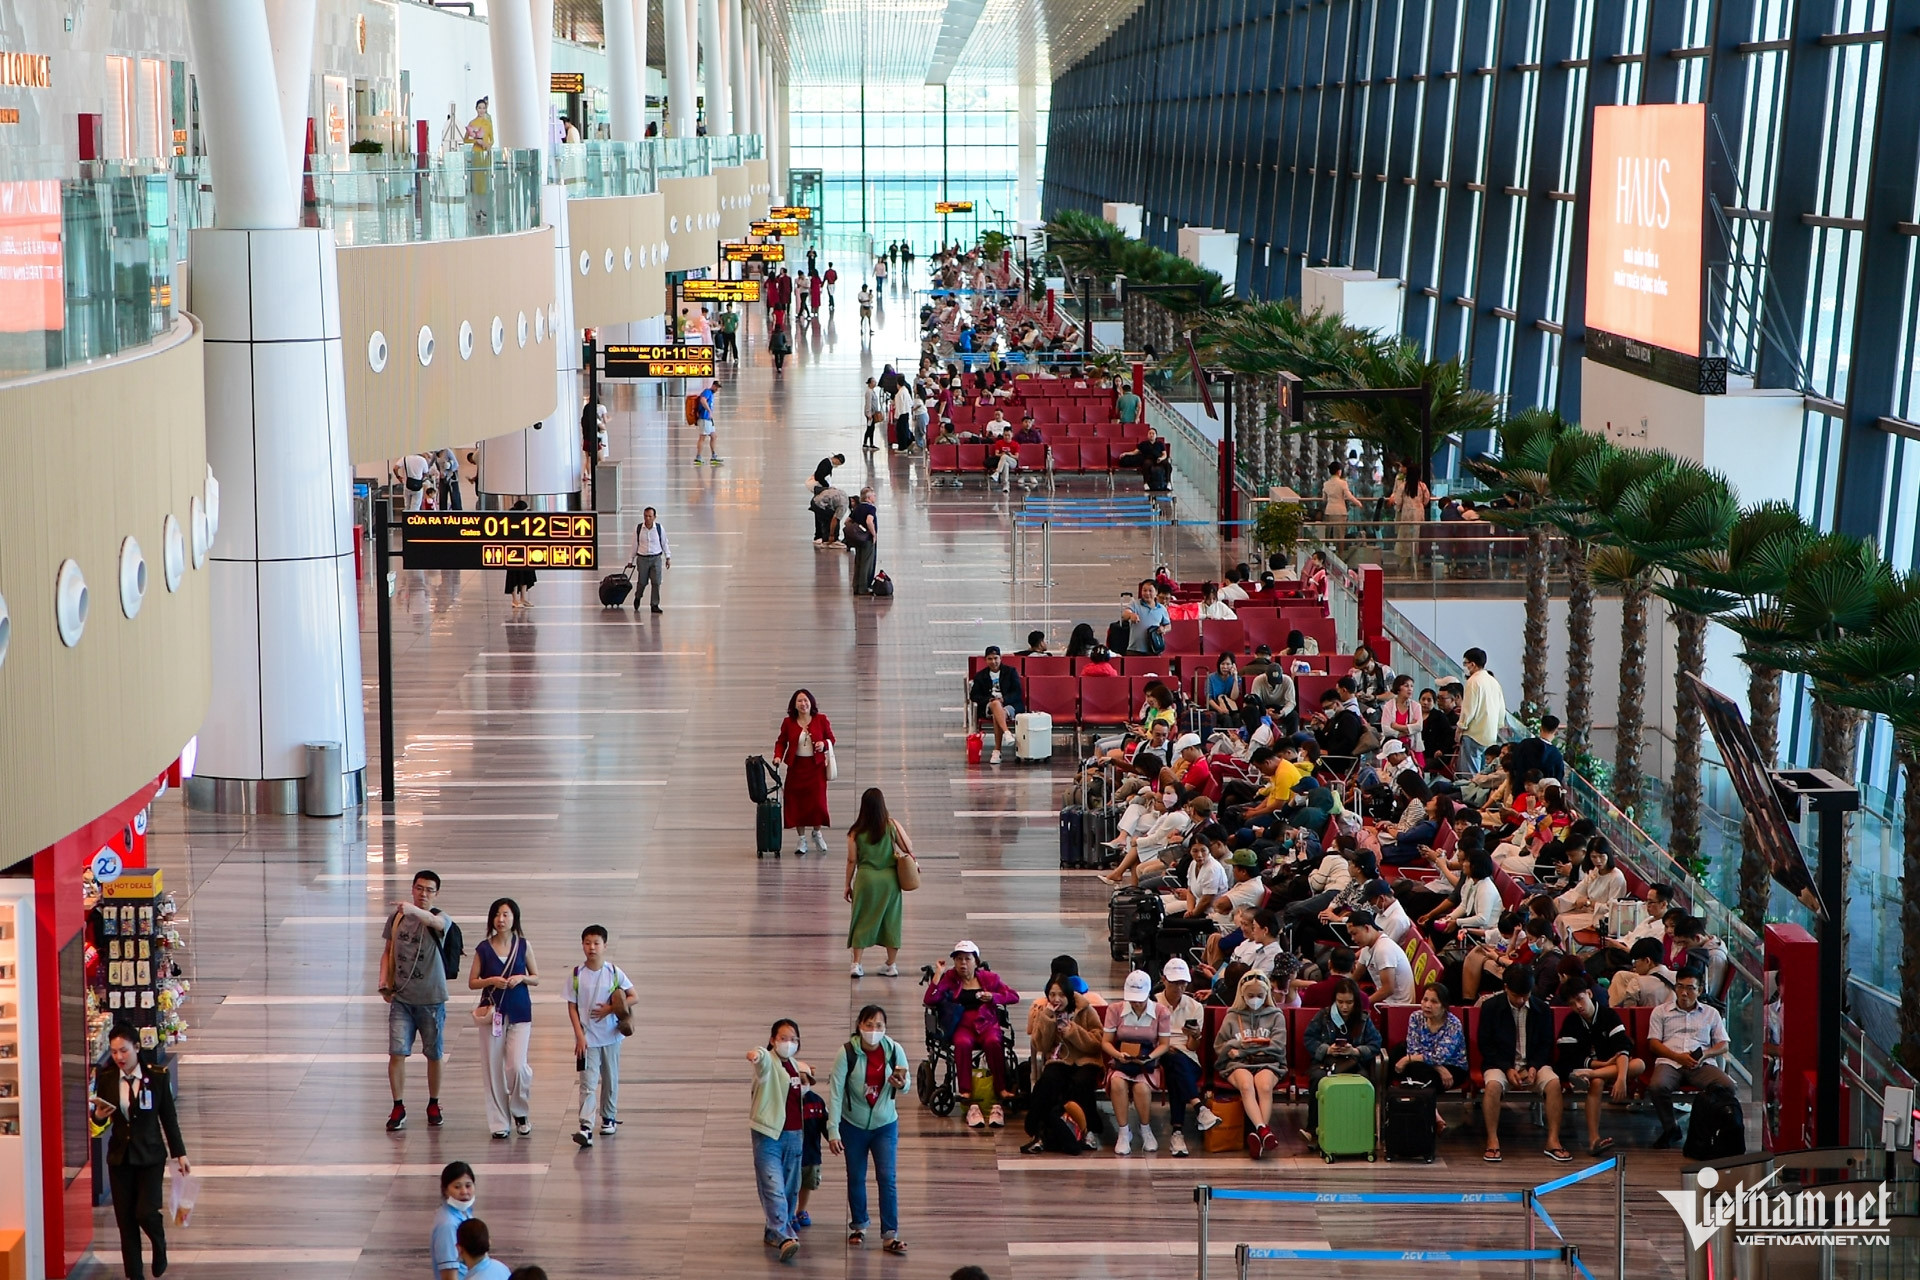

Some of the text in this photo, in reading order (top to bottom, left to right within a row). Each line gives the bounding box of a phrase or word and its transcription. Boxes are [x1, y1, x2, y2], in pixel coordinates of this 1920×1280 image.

[8, 53, 52, 88] LOUNGE
[1616, 156, 1671, 230] HAUS
[652, 347, 687, 359] 01-11
[407, 515, 547, 537] CỬA RA TÀU BAY 01-12
[460, 529, 481, 537] Gates
